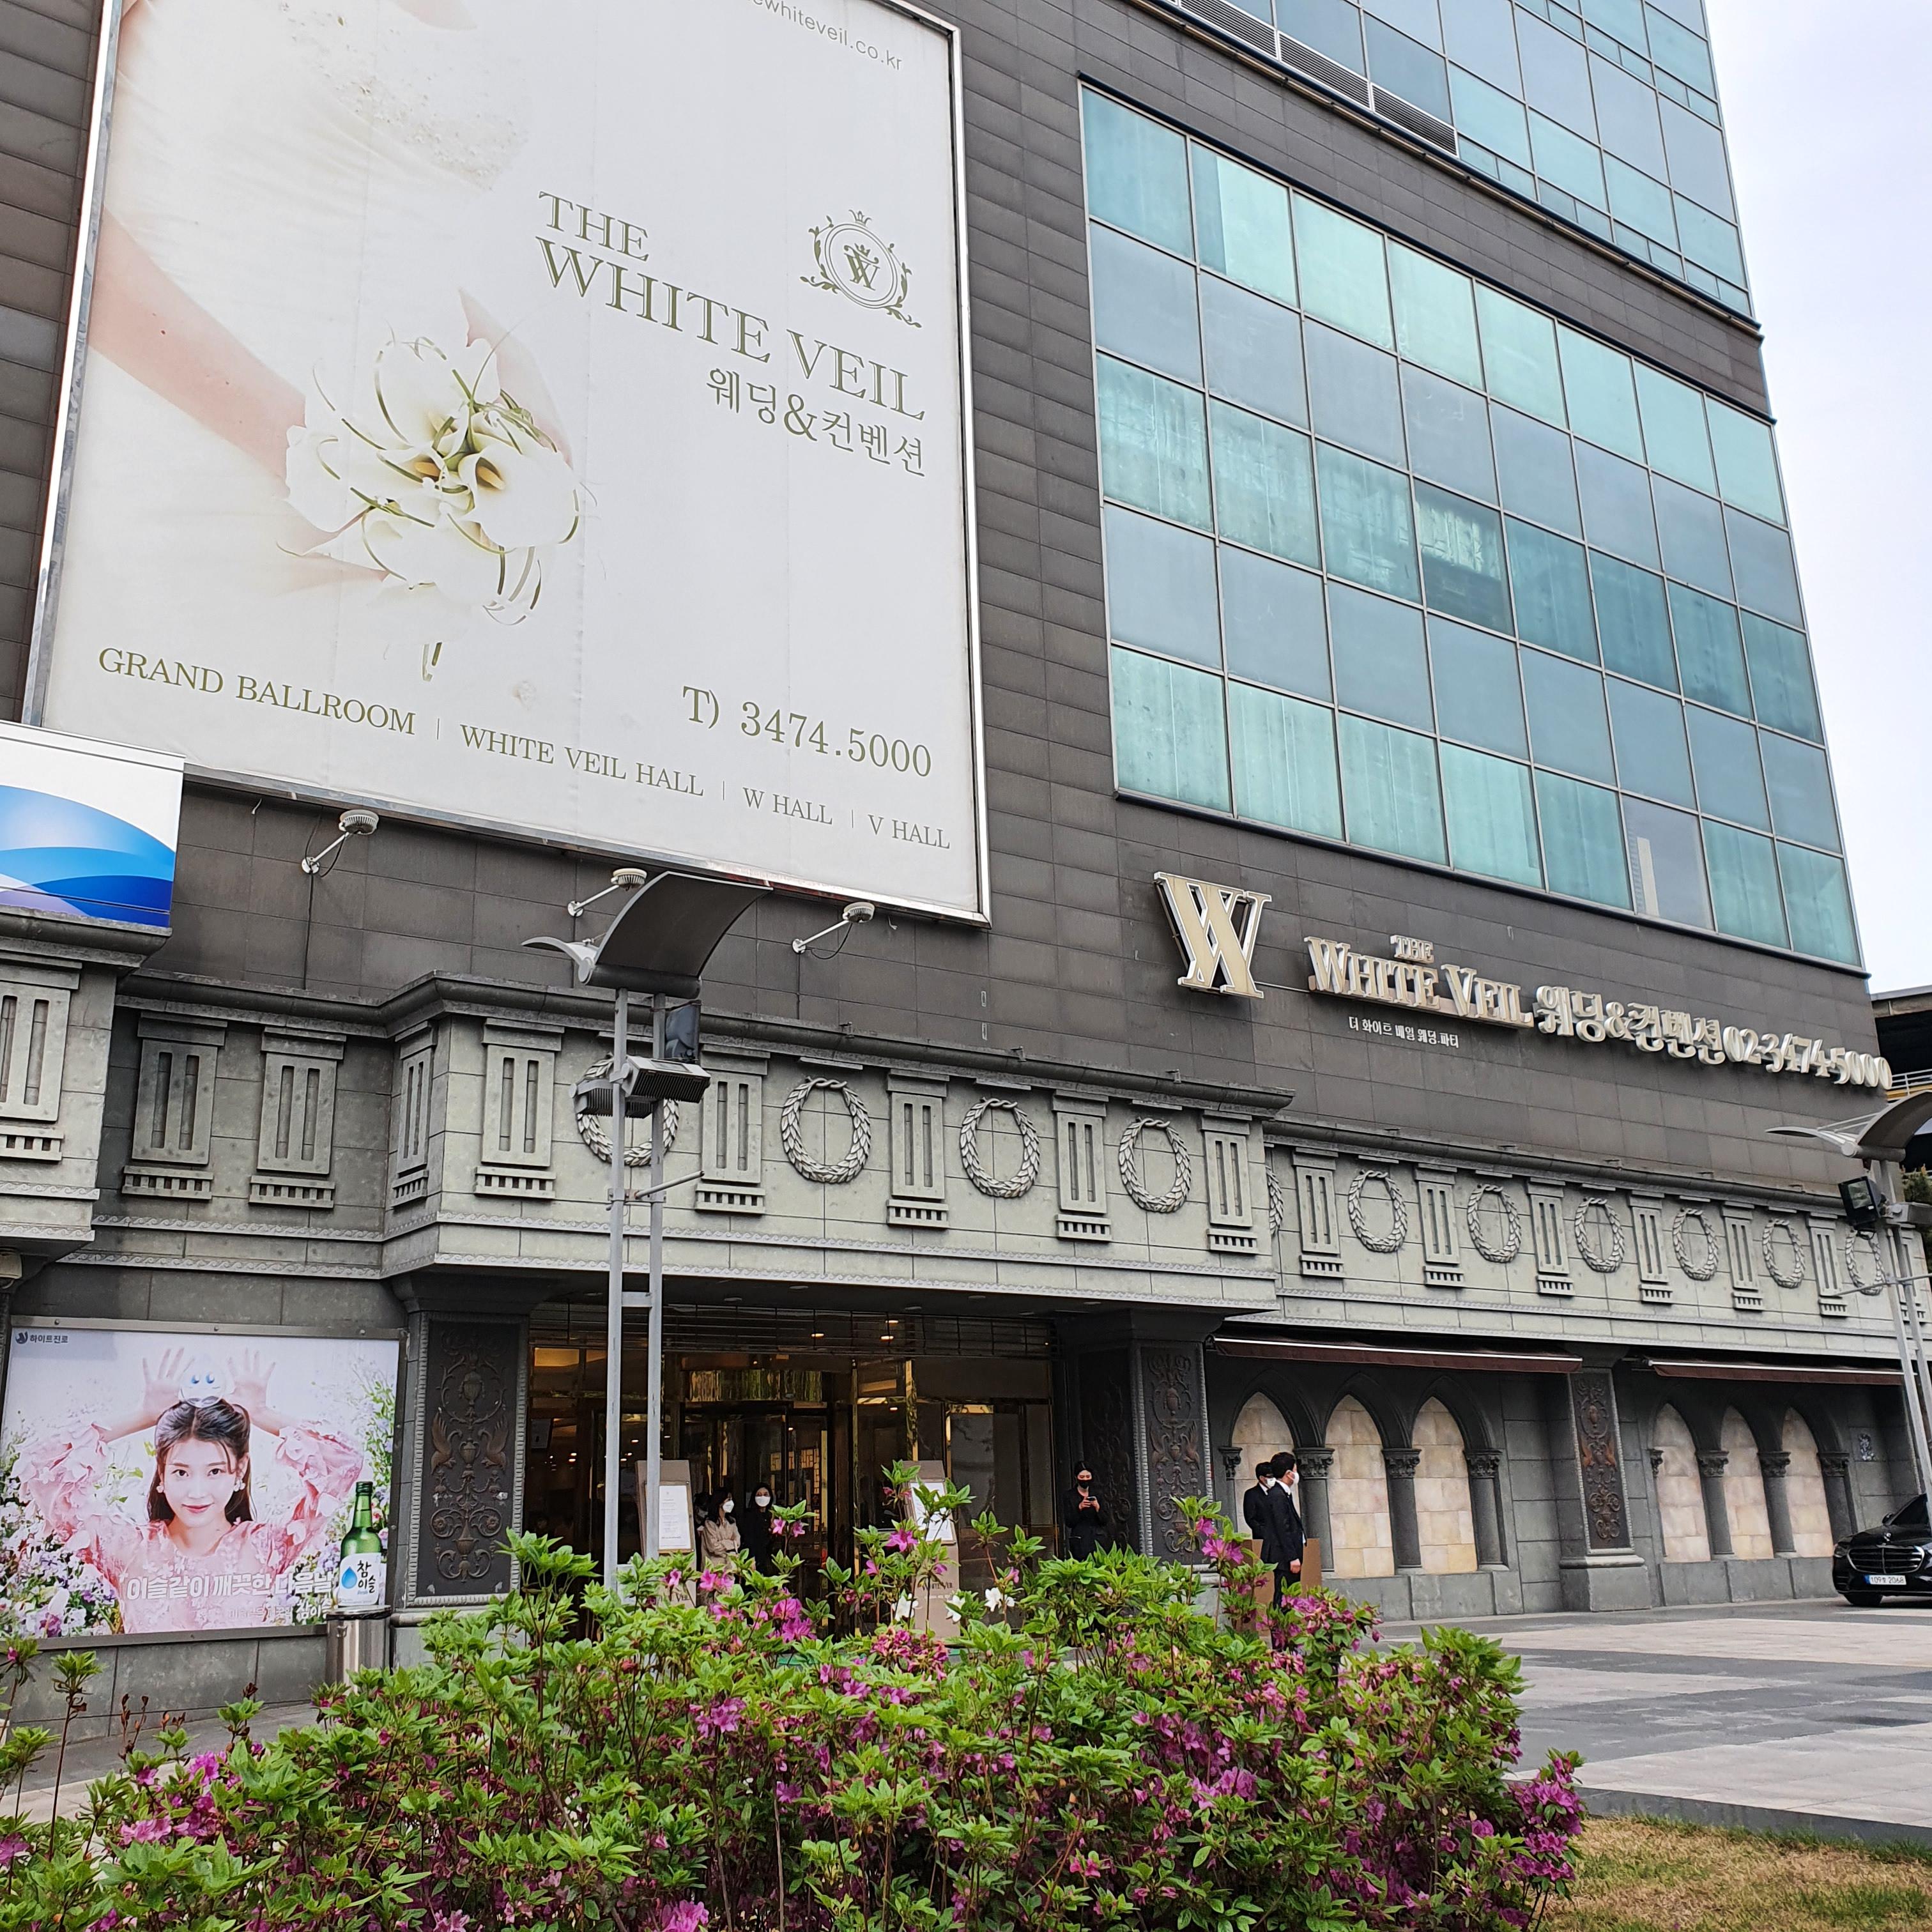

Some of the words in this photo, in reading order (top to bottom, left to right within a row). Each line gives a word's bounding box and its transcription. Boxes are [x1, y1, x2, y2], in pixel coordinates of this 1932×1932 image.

[539, 191, 649, 261] THE
[535, 236, 770, 363] WHITE
[786, 328, 925, 420] VEIL
[706, 367, 925, 477] 웨딩&컨벤션
[99, 647, 223, 693] GRAND
[236, 675, 415, 735] BALLROOM
[460, 724, 555, 764] WHITE
[564, 746, 627, 780] VEIL
[635, 762, 704, 797] HALL
[742, 787, 765, 809] W
[772, 793, 832, 825] HALL
[868, 814, 884, 835] V
[891, 819, 951, 849] HALL
[682, 686, 719, 730] T)
[740, 701, 931, 778] 3474.5000
[1304, 936, 1441, 1011] WHITE
[1440, 963, 1534, 1027] VEIL
[1390, 935, 1435, 963] THE
[1349, 1016, 1358, 1031] 더
[1362, 1019, 1393, 1036] 화이트
[1417, 1029, 1459, 1048] 웨딩.파티
[29, 1334, 68, 1344] 하이트진로
[127, 1574, 209, 1600] 이슬같이
[211, 1573, 271, 1596] 깨끗한
[274, 1570, 335, 1596] 다음날
